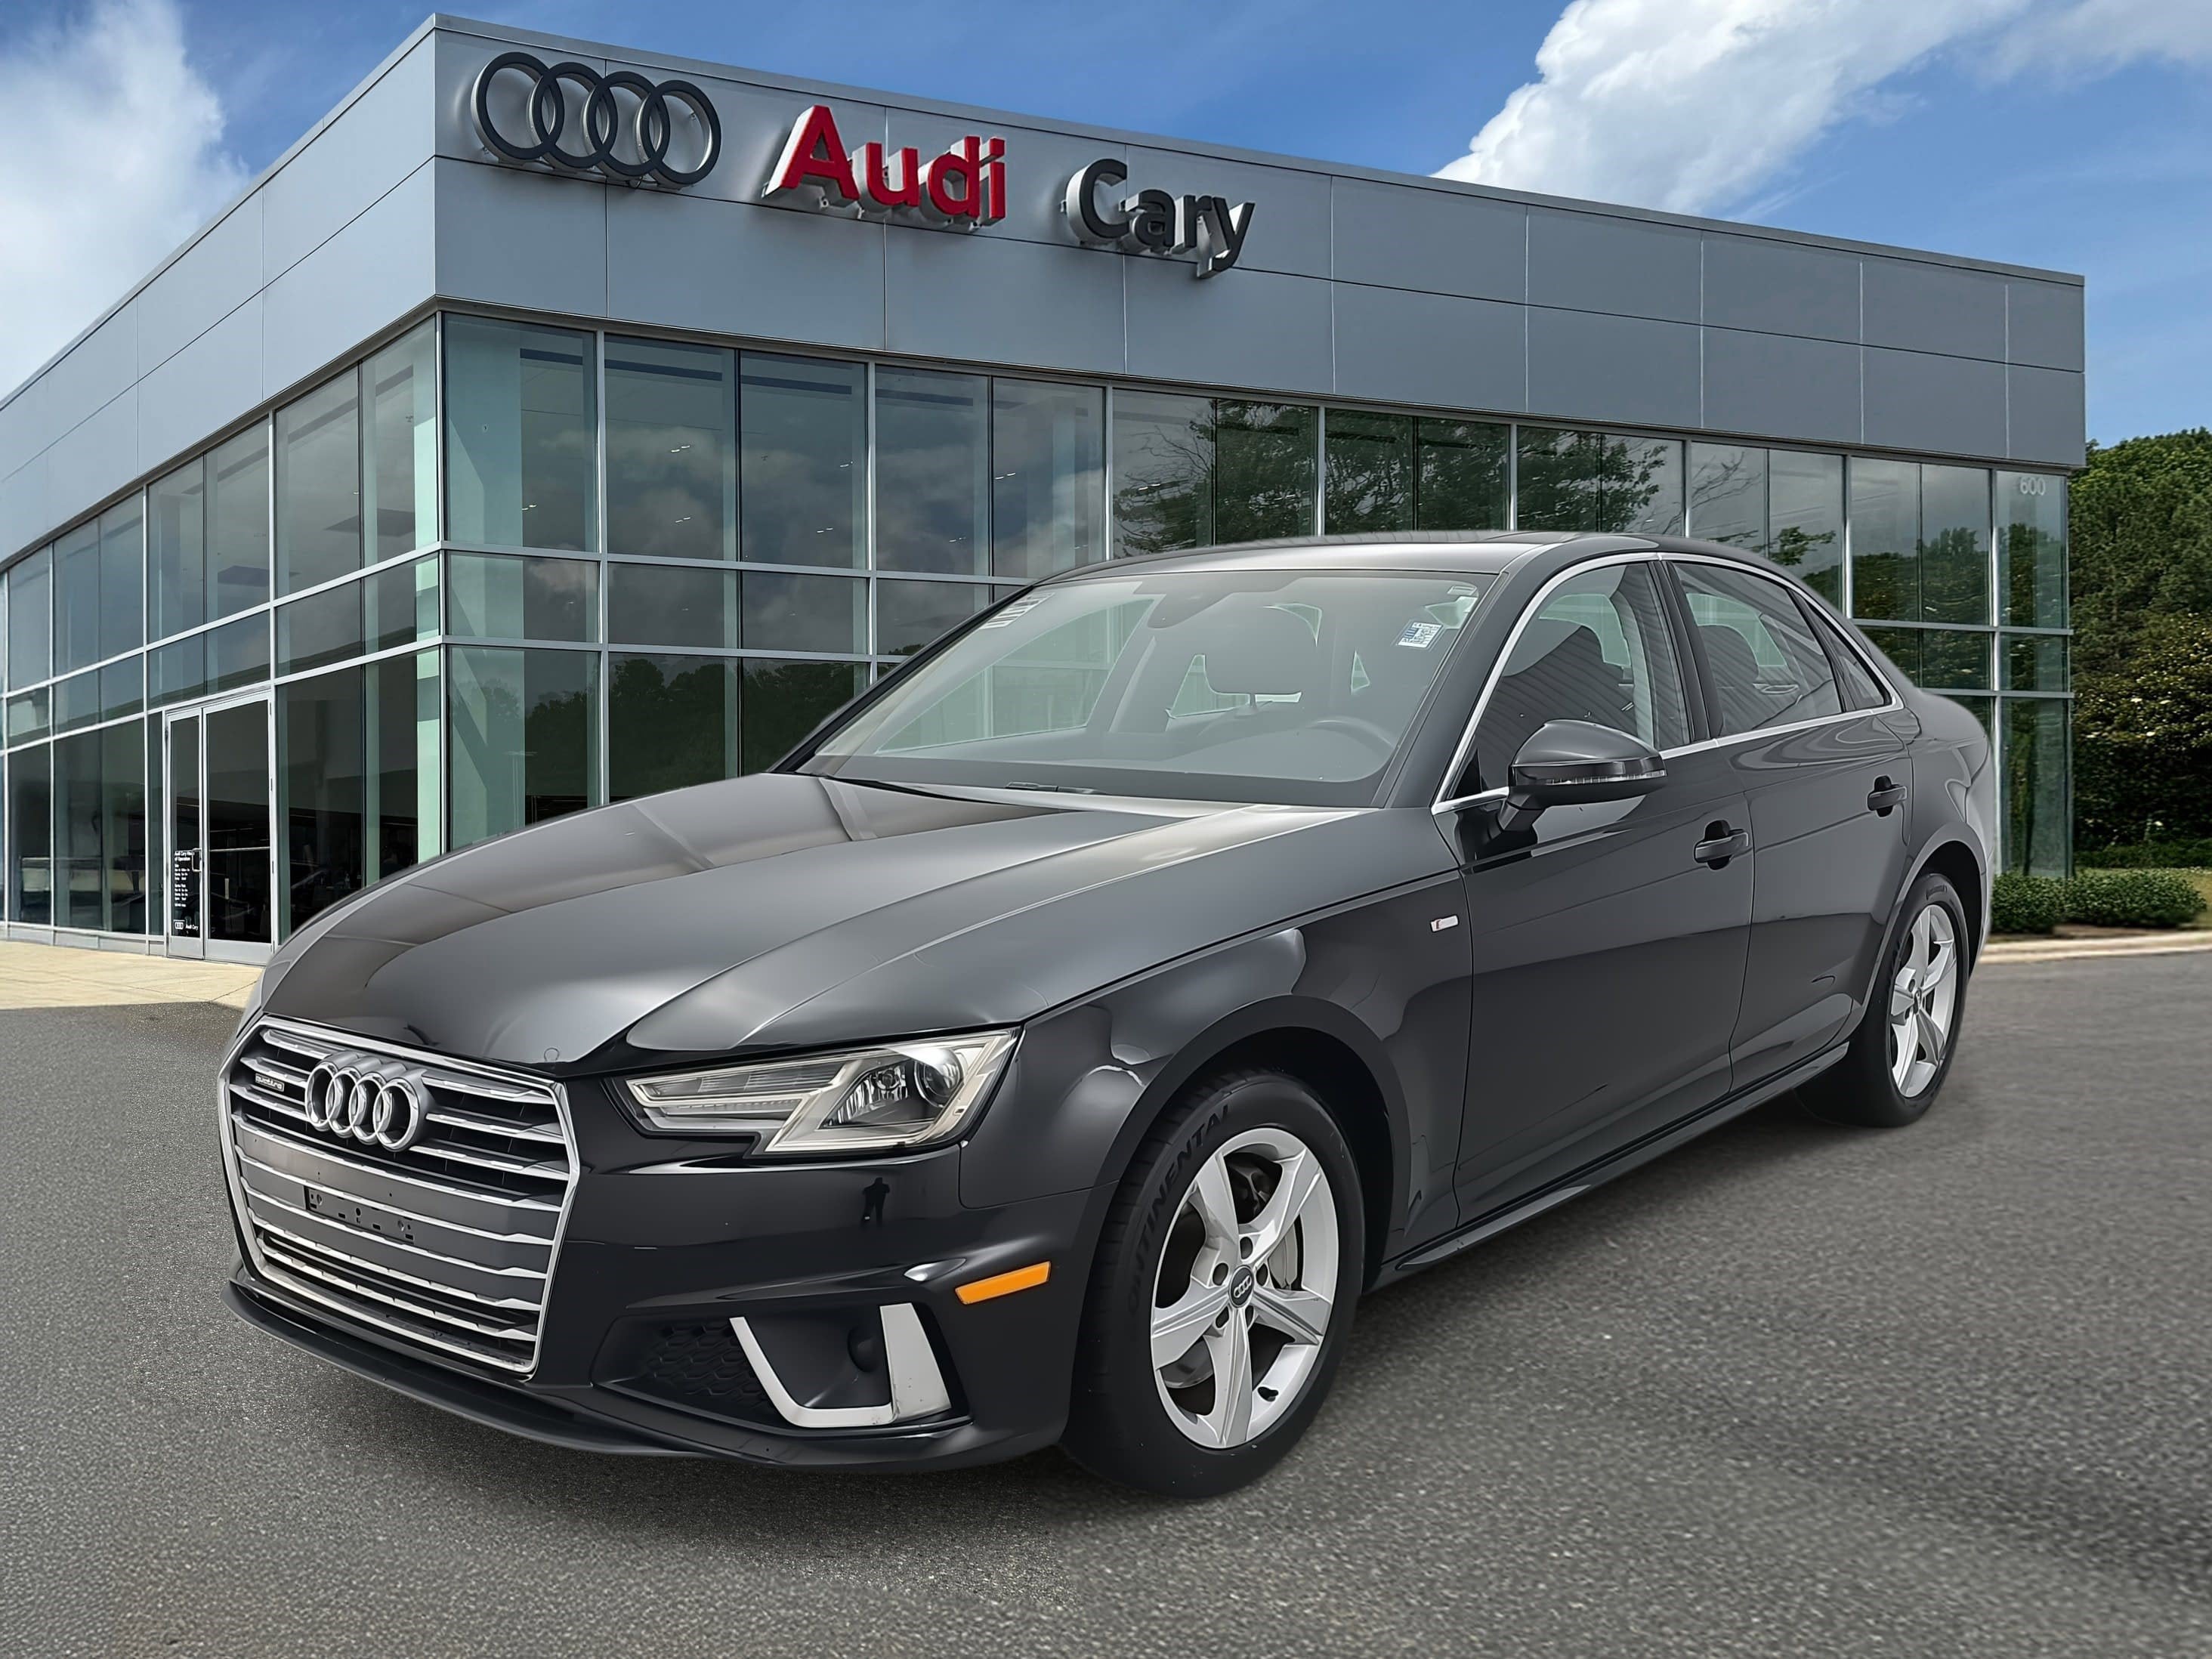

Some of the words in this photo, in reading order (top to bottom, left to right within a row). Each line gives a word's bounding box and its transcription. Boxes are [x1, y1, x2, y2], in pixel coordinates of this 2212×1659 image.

[774, 104, 1006, 224] Audi
[1071, 158, 1255, 276] Cary
[2019, 476, 2046, 496] 600
